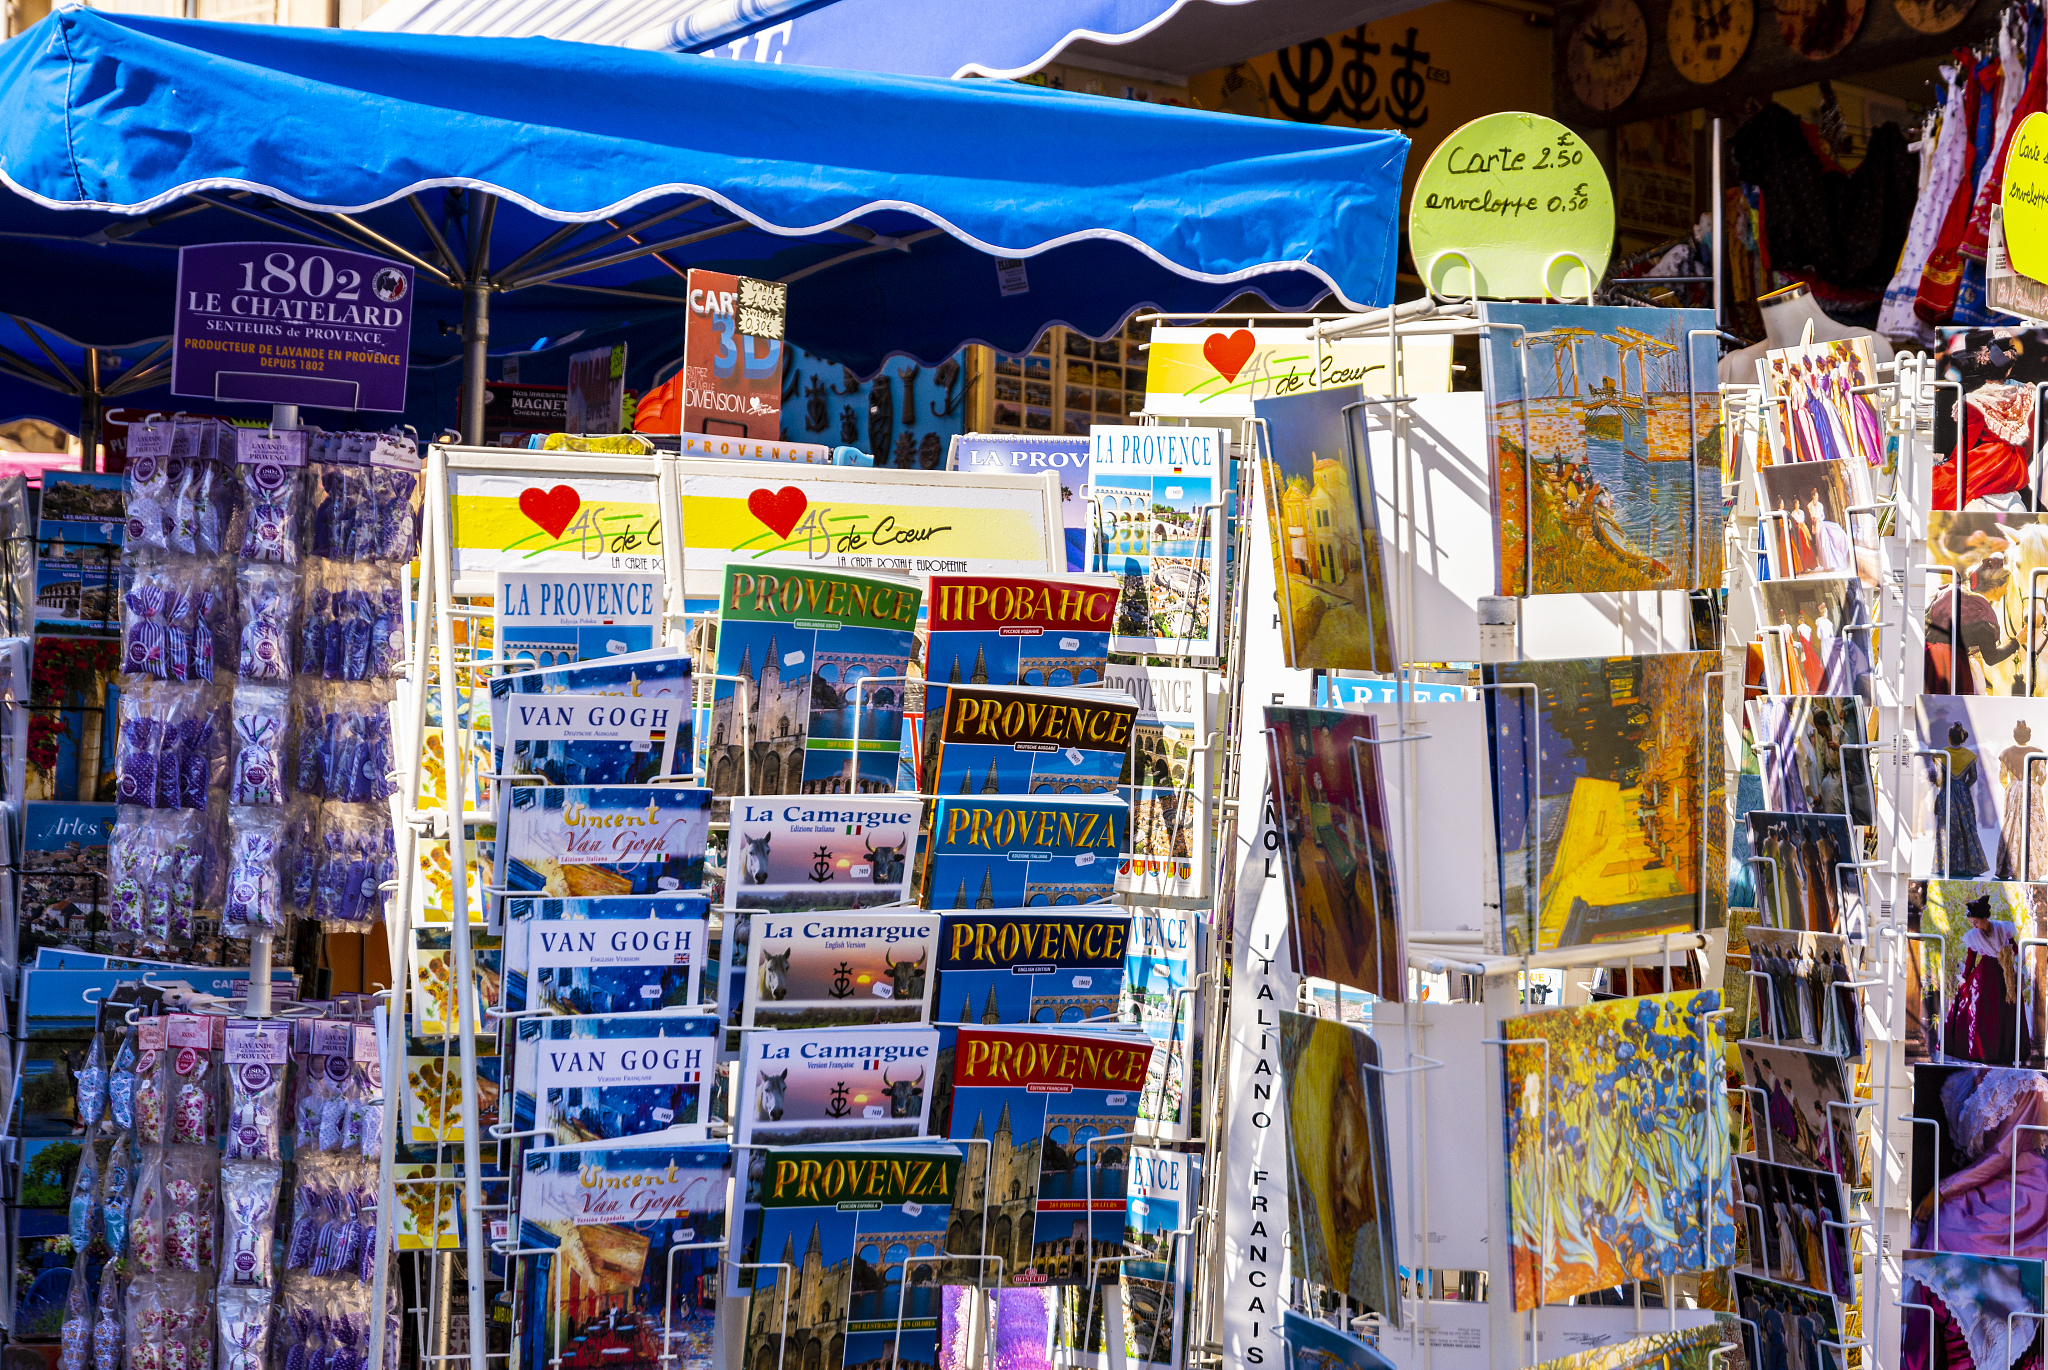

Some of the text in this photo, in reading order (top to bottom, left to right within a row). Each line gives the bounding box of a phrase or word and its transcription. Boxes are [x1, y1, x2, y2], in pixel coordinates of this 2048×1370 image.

[1447, 146, 1525, 175] Carte
[1425, 190, 1538, 217] enveloppe
[236, 252, 361, 300] 1802
[188, 291, 403, 327] LE CHATELARD
[206, 319, 382, 345] SENTEURS de PROVENCE
[184, 337, 400, 366] PRODUCTEUR DE LAVANDE EN PROVENCE
[260, 357, 324, 372] DEPUIS 1802
[1276, 366, 1303, 395] de
[686, 389, 745, 413] DIMENSION
[250, 453, 288, 461] PROVENCE
[686, 439, 814, 463] PROVENCE
[970, 450, 1090, 468] LA PROV
[1096, 434, 1212, 466] LA PROVENCE
[611, 525, 642, 553] de
[837, 525, 866, 554] de
[612, 557, 621, 570] LA
[625, 558, 648, 571] CARTE
[504, 582, 654, 617] LA PROVENCE
[729, 572, 914, 624] PROVENCE
[939, 585, 1110, 623] ПРОВАНС
[519, 706, 669, 728] VAN GOGH
[953, 698, 1131, 745] PROVENCE
[562, 797, 659, 829] Vincent
[744, 806, 912, 828] La Camargue
[37, 817, 97, 841] Arles
[790, 825, 835, 833] Edizione Italiana
[945, 808, 1116, 850] PROVENZA
[561, 855, 584, 863] Edizione
[564, 819, 686, 873] Van Gogh
[540, 931, 692, 952] VAN GOGH
[763, 922, 931, 943] La Camargue
[825, 941, 866, 949] English Version
[950, 922, 1125, 965] PROVENCE
[239, 1042, 273, 1050] LAVANDE
[760, 1042, 929, 1063] La Camargue
[550, 1049, 702, 1072] VAN GOGH
[807, 1060, 854, 1070] Version Française
[964, 1040, 1145, 1084] PROVENCE
[578, 1158, 679, 1189] Vincent
[772, 1159, 949, 1202] PROVENZA
[1129, 1156, 1180, 1191] ENCE
[581, 1177, 707, 1231] Van Gogh
[577, 1214, 625, 1225] Versión Española
